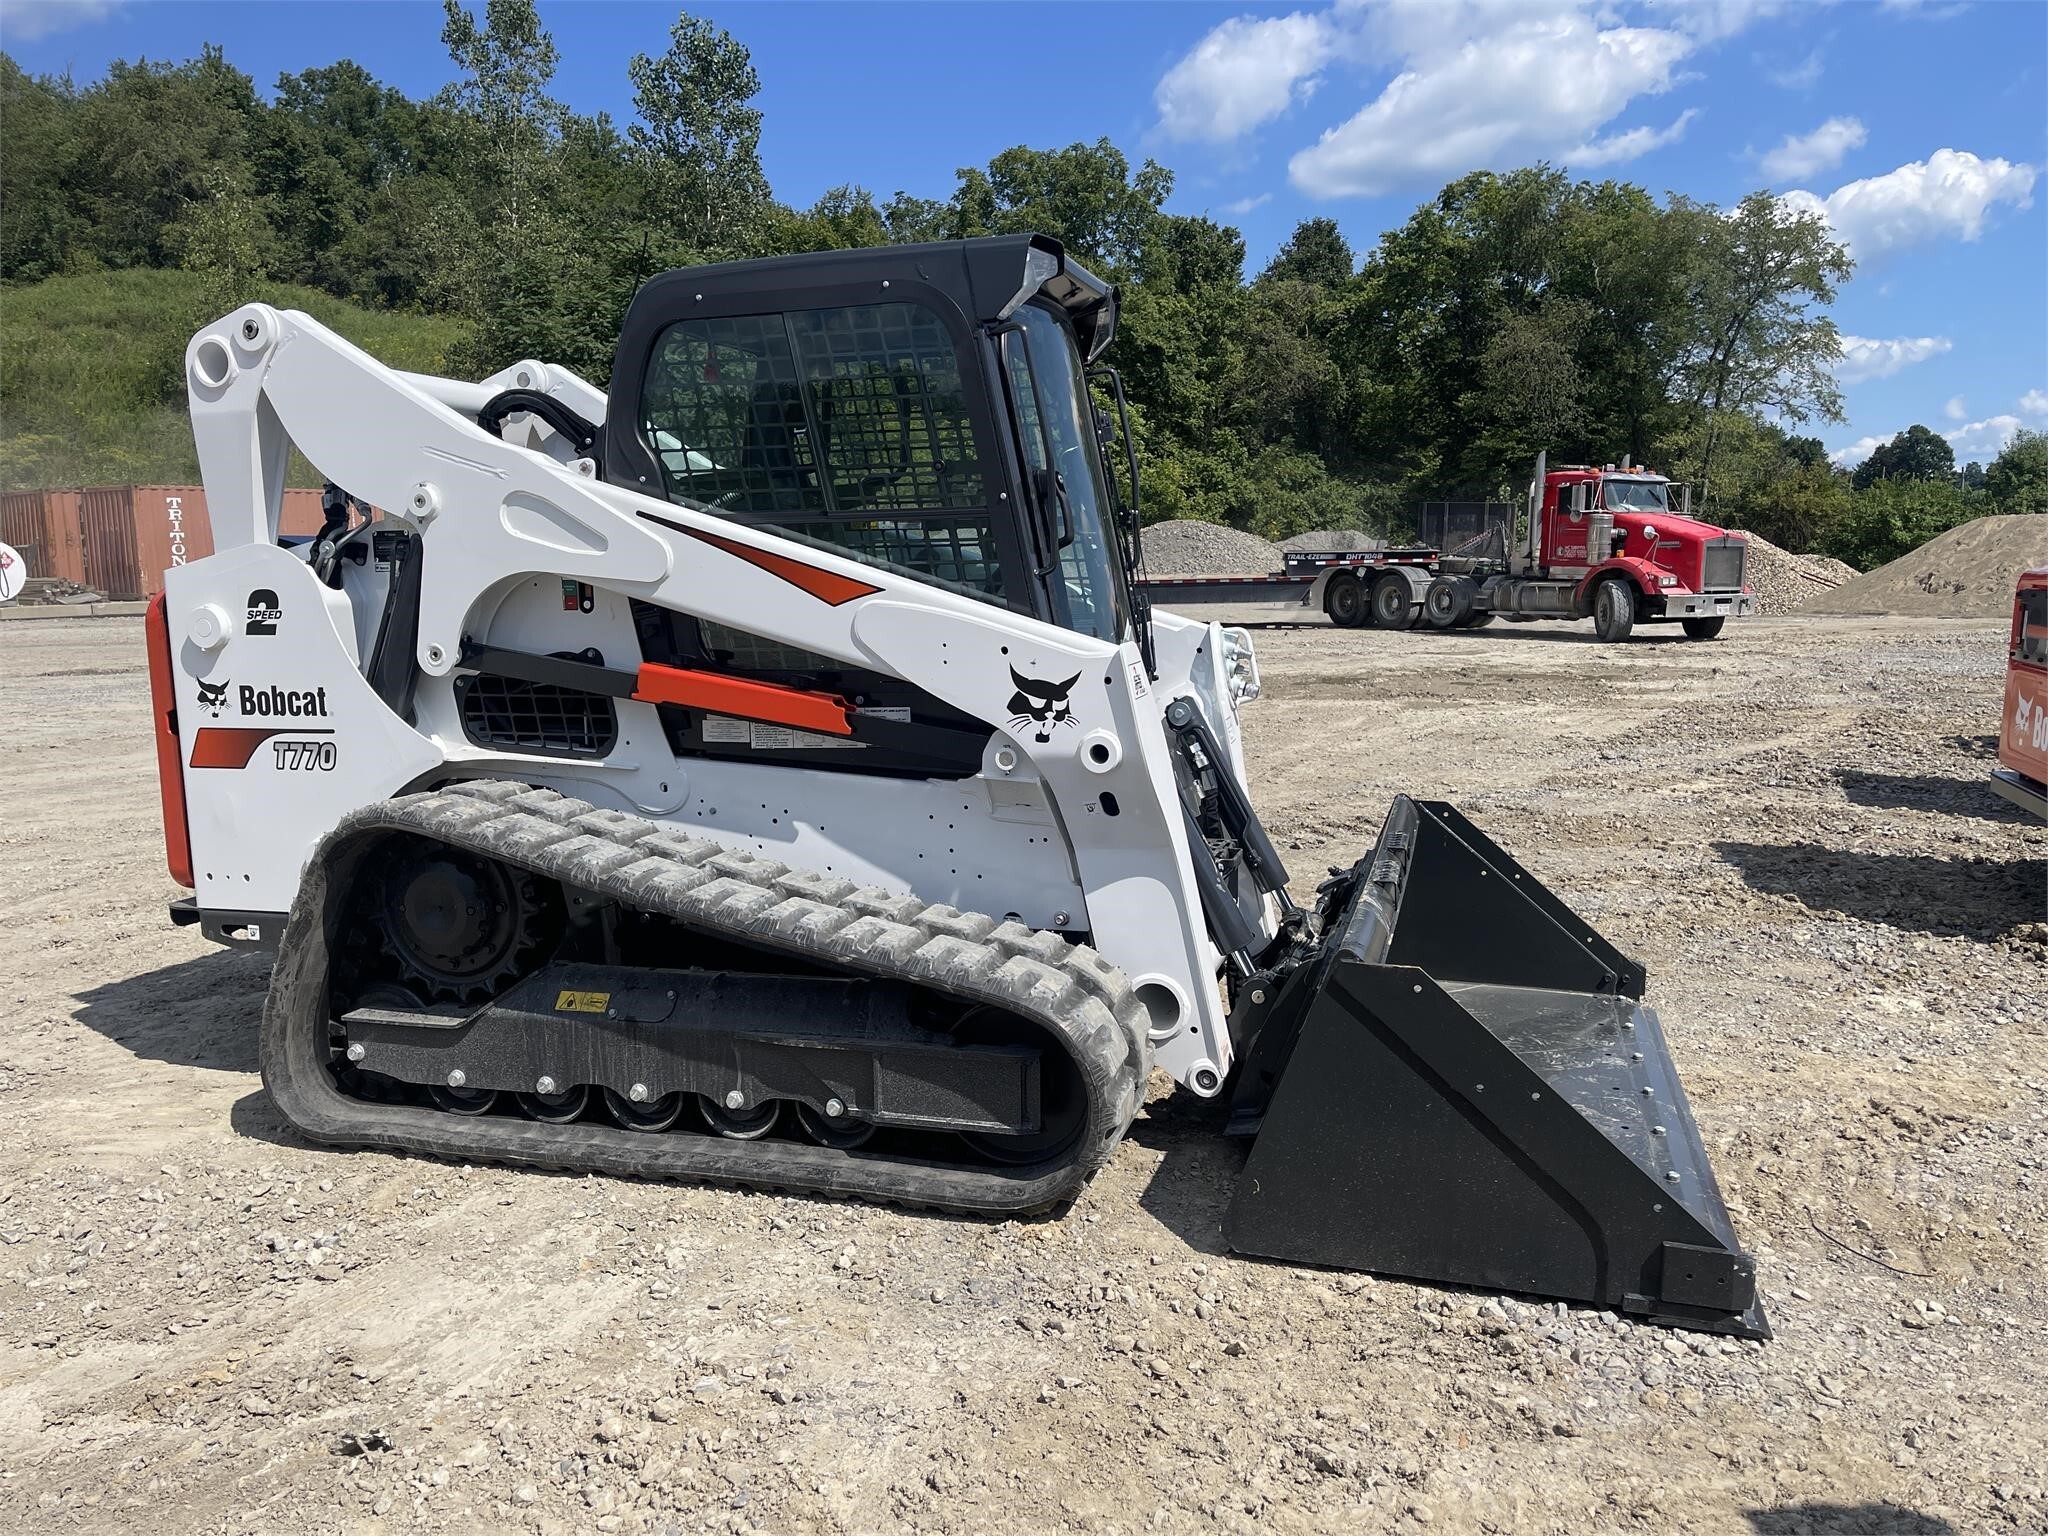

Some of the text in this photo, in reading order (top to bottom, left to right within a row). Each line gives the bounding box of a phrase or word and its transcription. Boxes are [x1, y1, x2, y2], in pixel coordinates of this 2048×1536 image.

[166, 497, 187, 567] TRITON
[245, 588, 280, 636] 2
[246, 609, 283, 620] SPEED
[238, 685, 328, 717] Bobcat
[273, 741, 337, 771] T770
